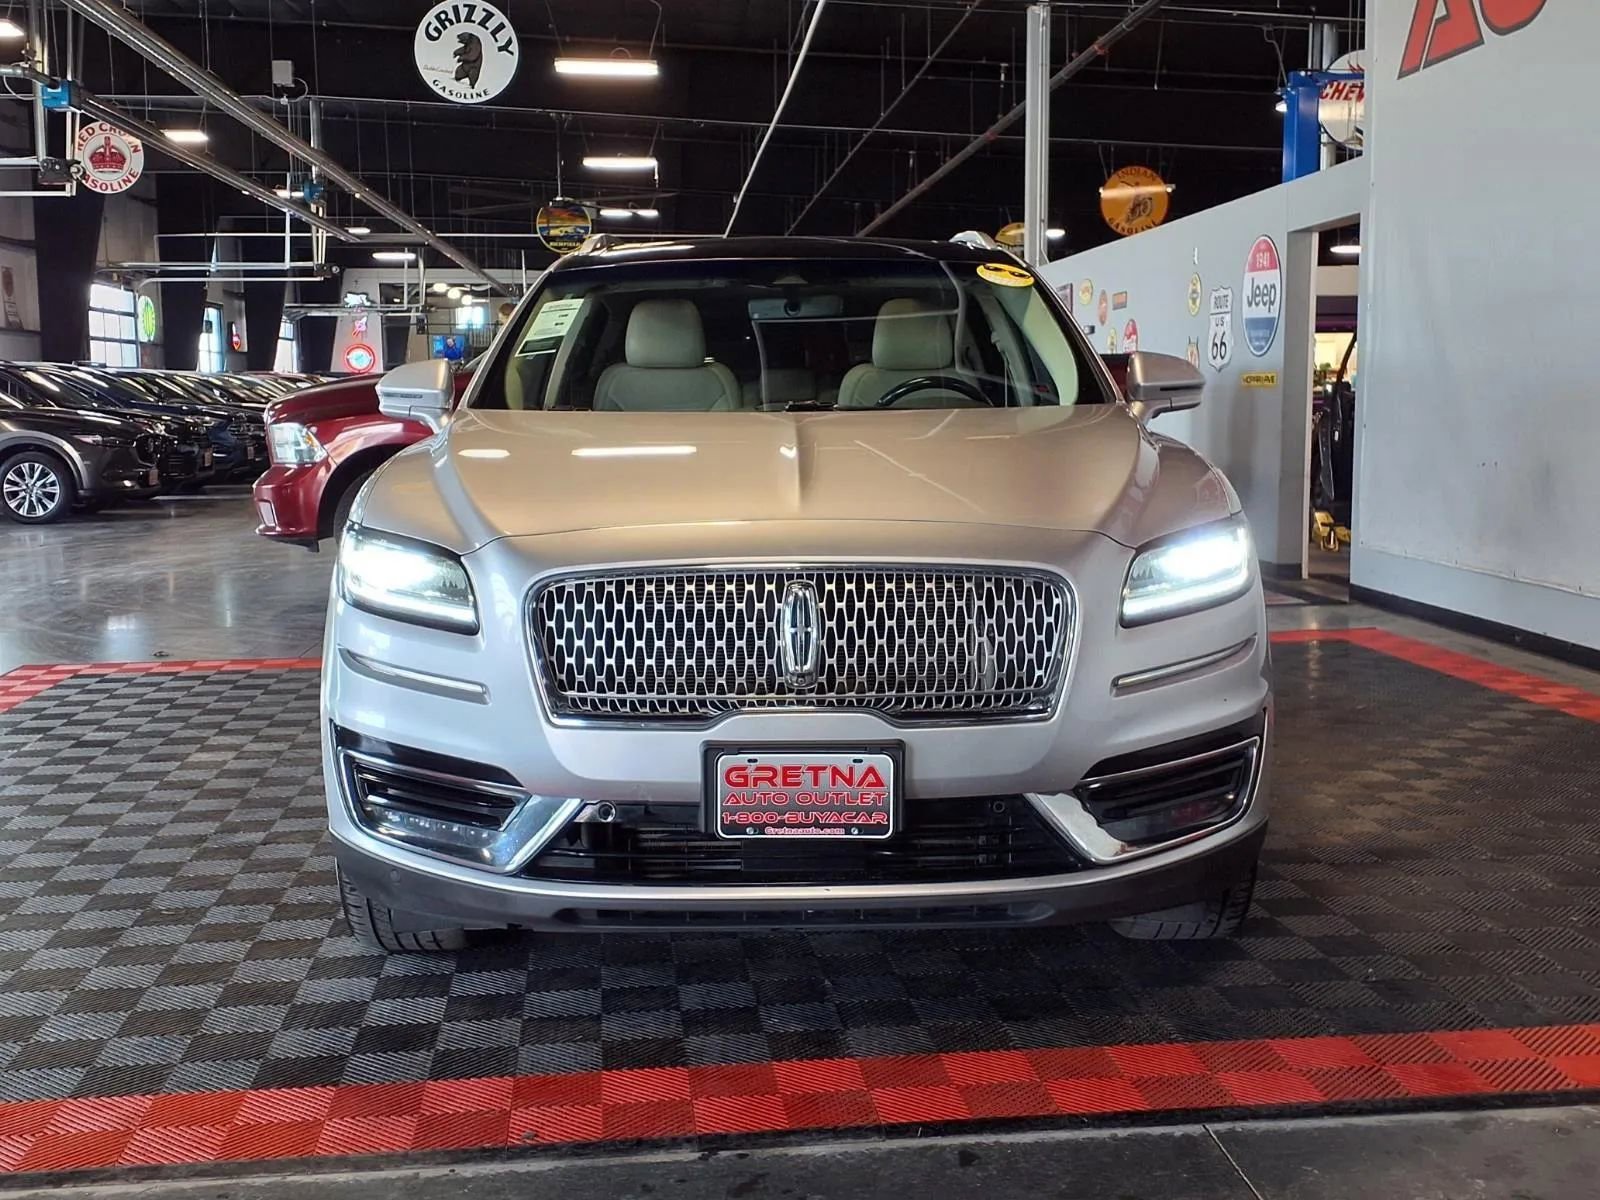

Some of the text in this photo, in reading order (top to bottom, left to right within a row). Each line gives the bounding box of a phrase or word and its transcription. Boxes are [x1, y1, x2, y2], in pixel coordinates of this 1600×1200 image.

[424, 3, 515, 56] GRIZZLY
[432, 79, 491, 100] GASOLINE
[98, 122, 142, 154] CRN
[83, 167, 140, 192] ASOLINE
[1246, 277, 1277, 313] Jeep
[1211, 331, 1227, 360] 66
[723, 764, 888, 789] GRETNA
[723, 792, 888, 806] AUTO OUTLET
[722, 811, 888, 825] 1-800-BUYACAR
[764, 826, 846, 835] Gretnaauto.com
